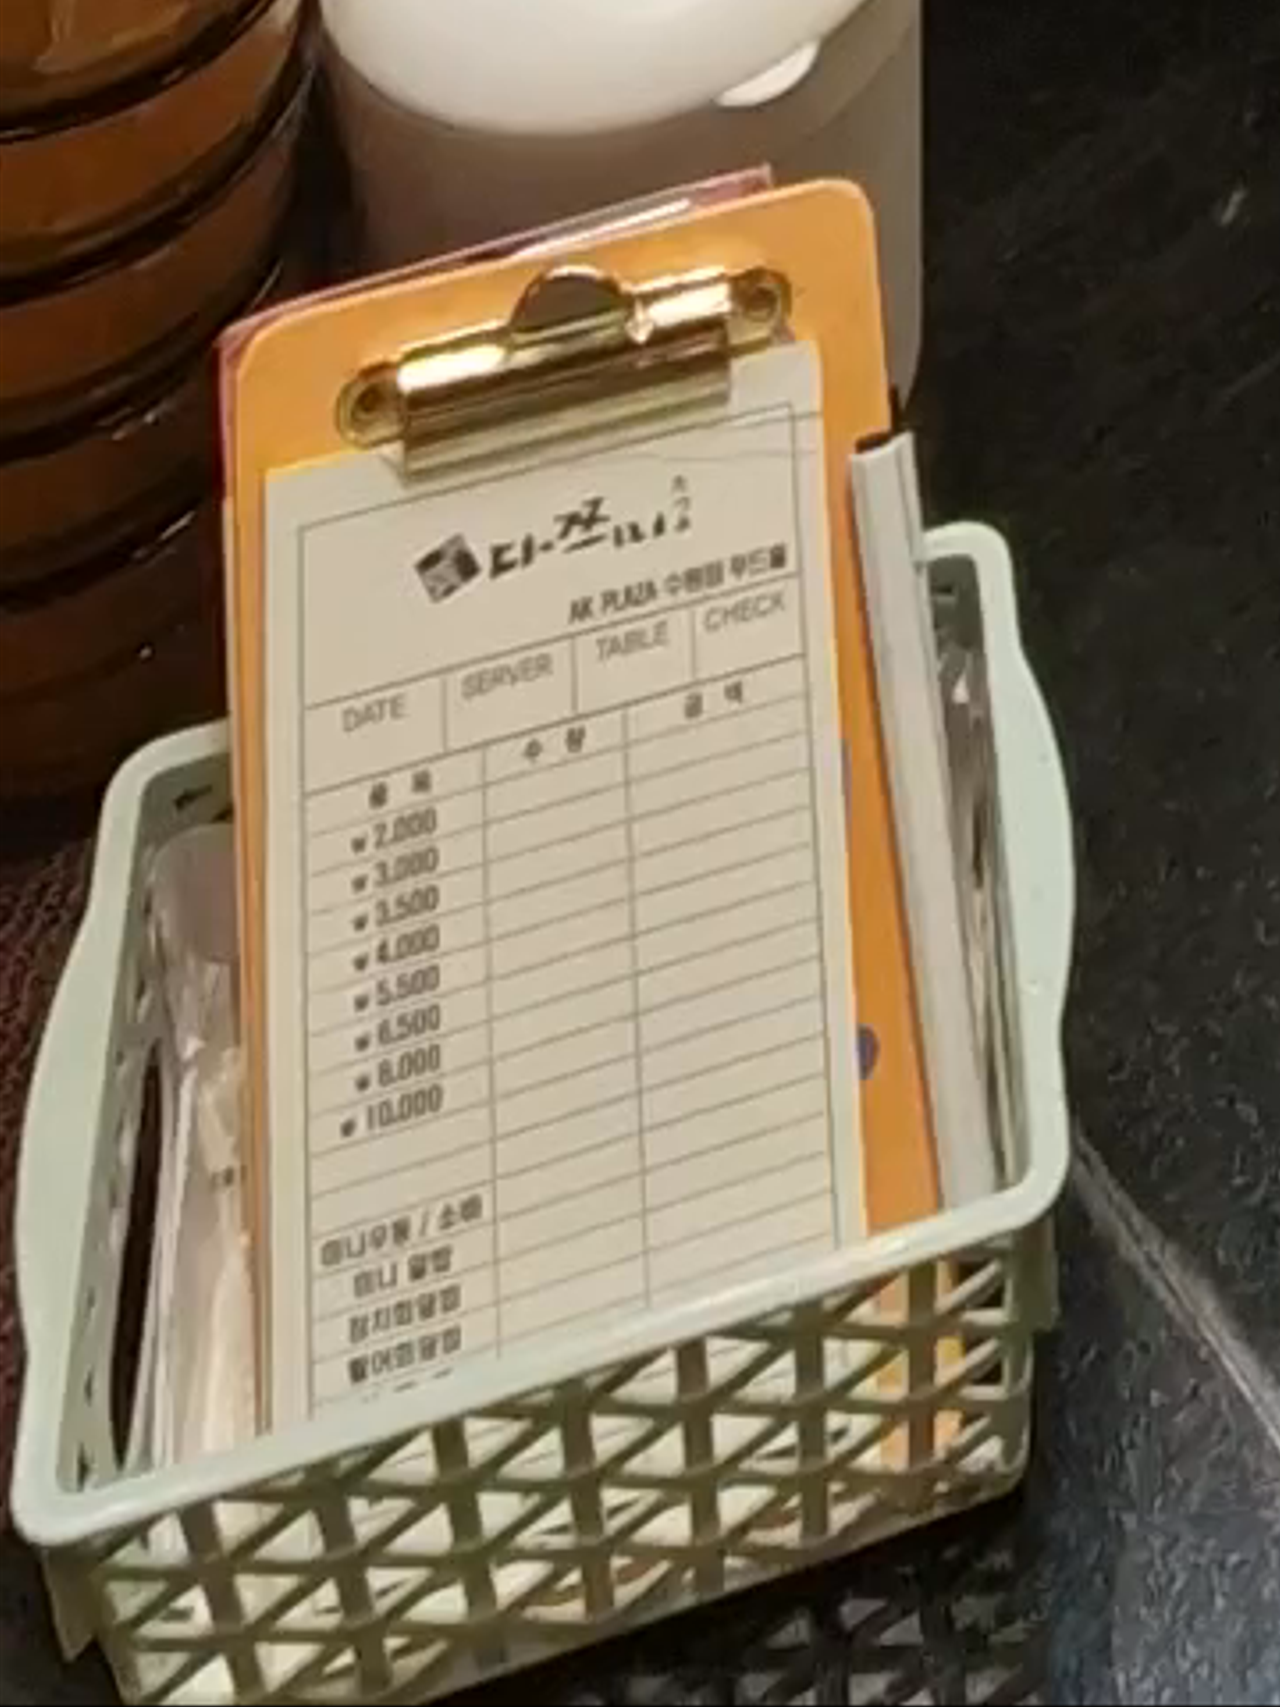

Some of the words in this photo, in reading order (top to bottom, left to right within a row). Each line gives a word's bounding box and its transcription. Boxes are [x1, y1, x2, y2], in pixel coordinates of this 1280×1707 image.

[569, 596, 595, 624] AK
[602, 580, 658, 615] PLAZA
[342, 693, 406, 733] DATE
[462, 653, 553, 701] SERVER
[595, 621, 670, 663] TABLE
[703, 590, 787, 633] CHECK
[321, 1215, 410, 1266] 미니우동
[354, 1261, 397, 1298] 미니
